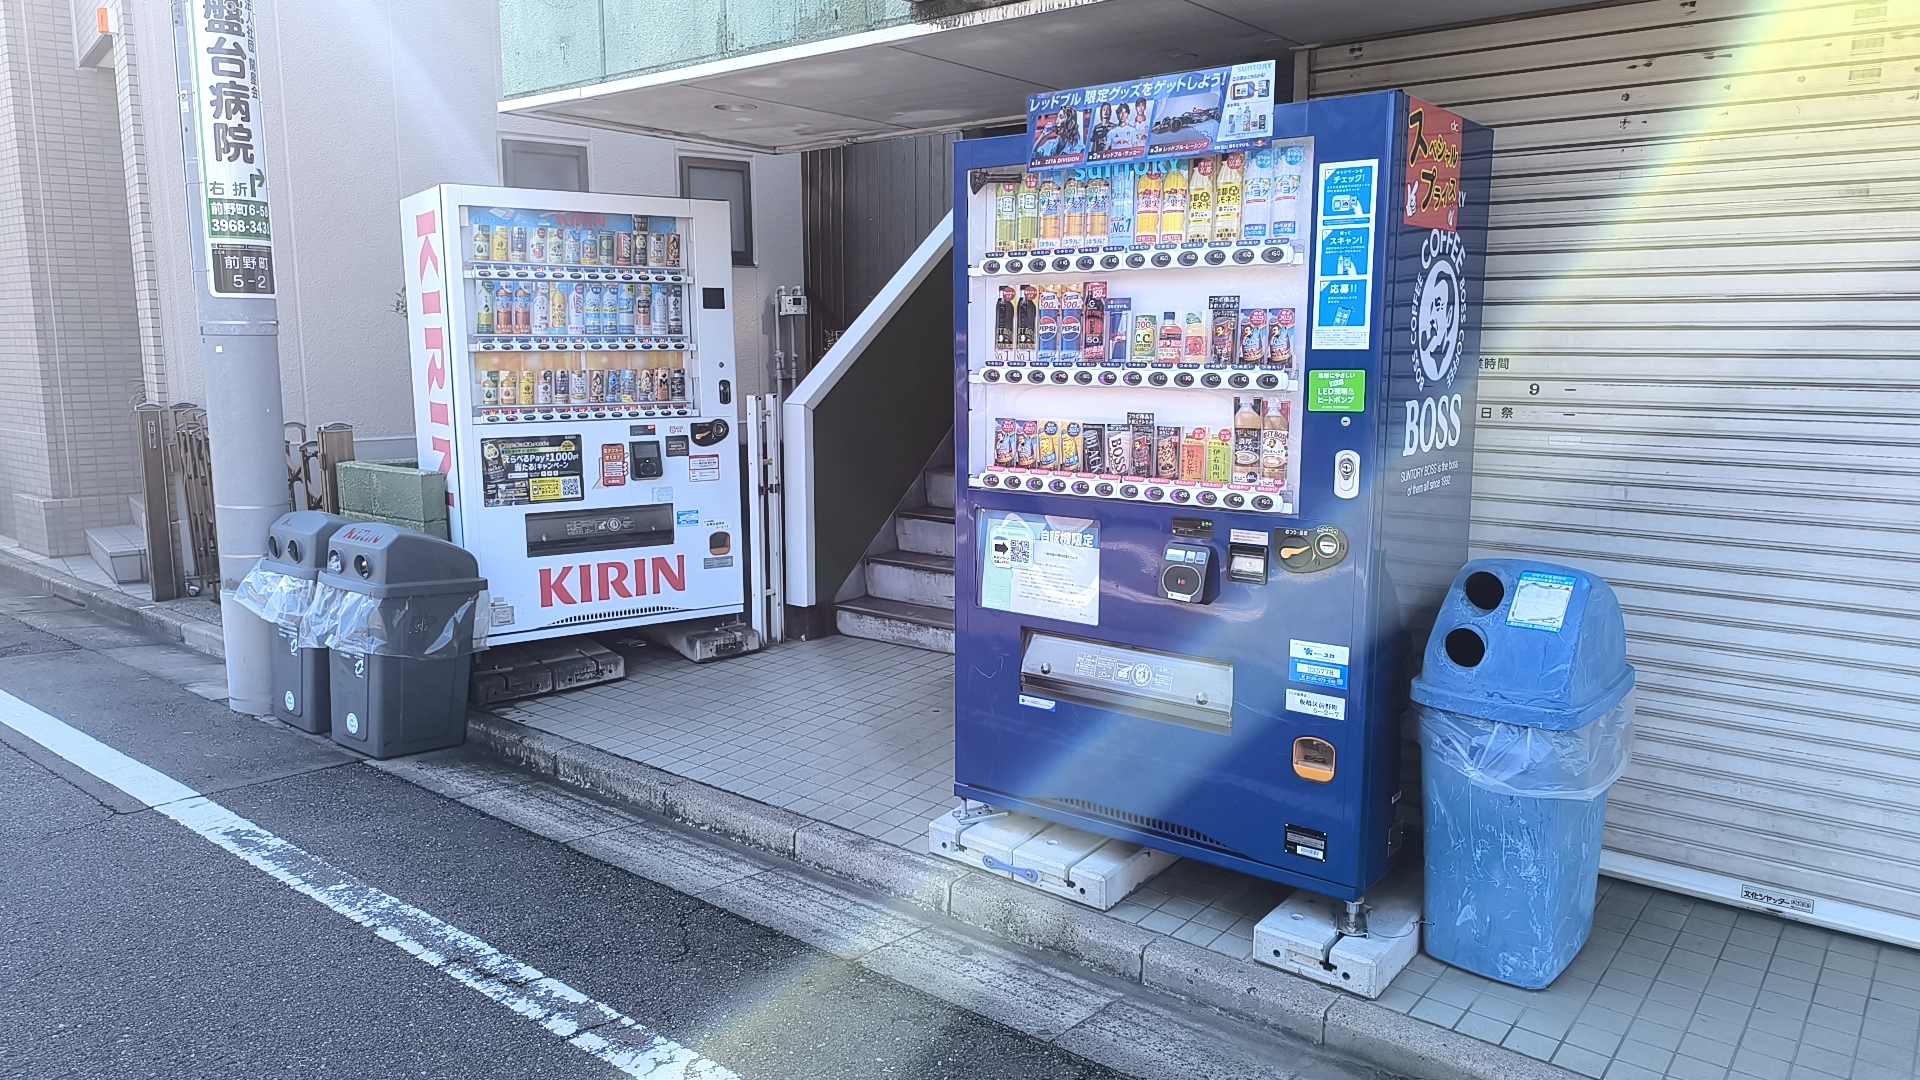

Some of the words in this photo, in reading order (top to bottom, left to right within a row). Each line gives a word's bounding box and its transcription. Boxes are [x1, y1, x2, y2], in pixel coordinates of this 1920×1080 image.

[1237, 62, 1272, 73] SUNTORY
[1030, 93, 1082, 112] レッドブル
[1057, 156, 1080, 164] DIVISION
[1333, 174, 1365, 184] チェック!
[1045, 199, 1060, 212] 麦茶
[1070, 196, 1084, 209] 麦茶
[1093, 195, 1108, 208] 麦茶
[557, 213, 606, 228] KIRIN
[1329, 236, 1363, 246] スキャン!
[224, 256, 269, 271] 前野町
[233, 274, 267, 289] 5-2
[1329, 283, 1358, 294] 応募!!
[1529, 383, 1540, 396] 9
[1317, 396, 1355, 404] ヒートポンプ
[1402, 393, 1462, 457] BOSS
[1086, 433, 1103, 474] BLACK
[1111, 437, 1127, 474] BOSS
[1400, 466, 1424, 483] SUNTORY
[1424, 462, 1438, 477] BOSS
[1441, 461, 1449, 472] the
[1448, 459, 1459, 470] boss
[1412, 483, 1423, 495] them
[1429, 478, 1441, 490] since
[1441, 474, 1451, 486] 1992
[538, 555, 686, 608] KIRIN
